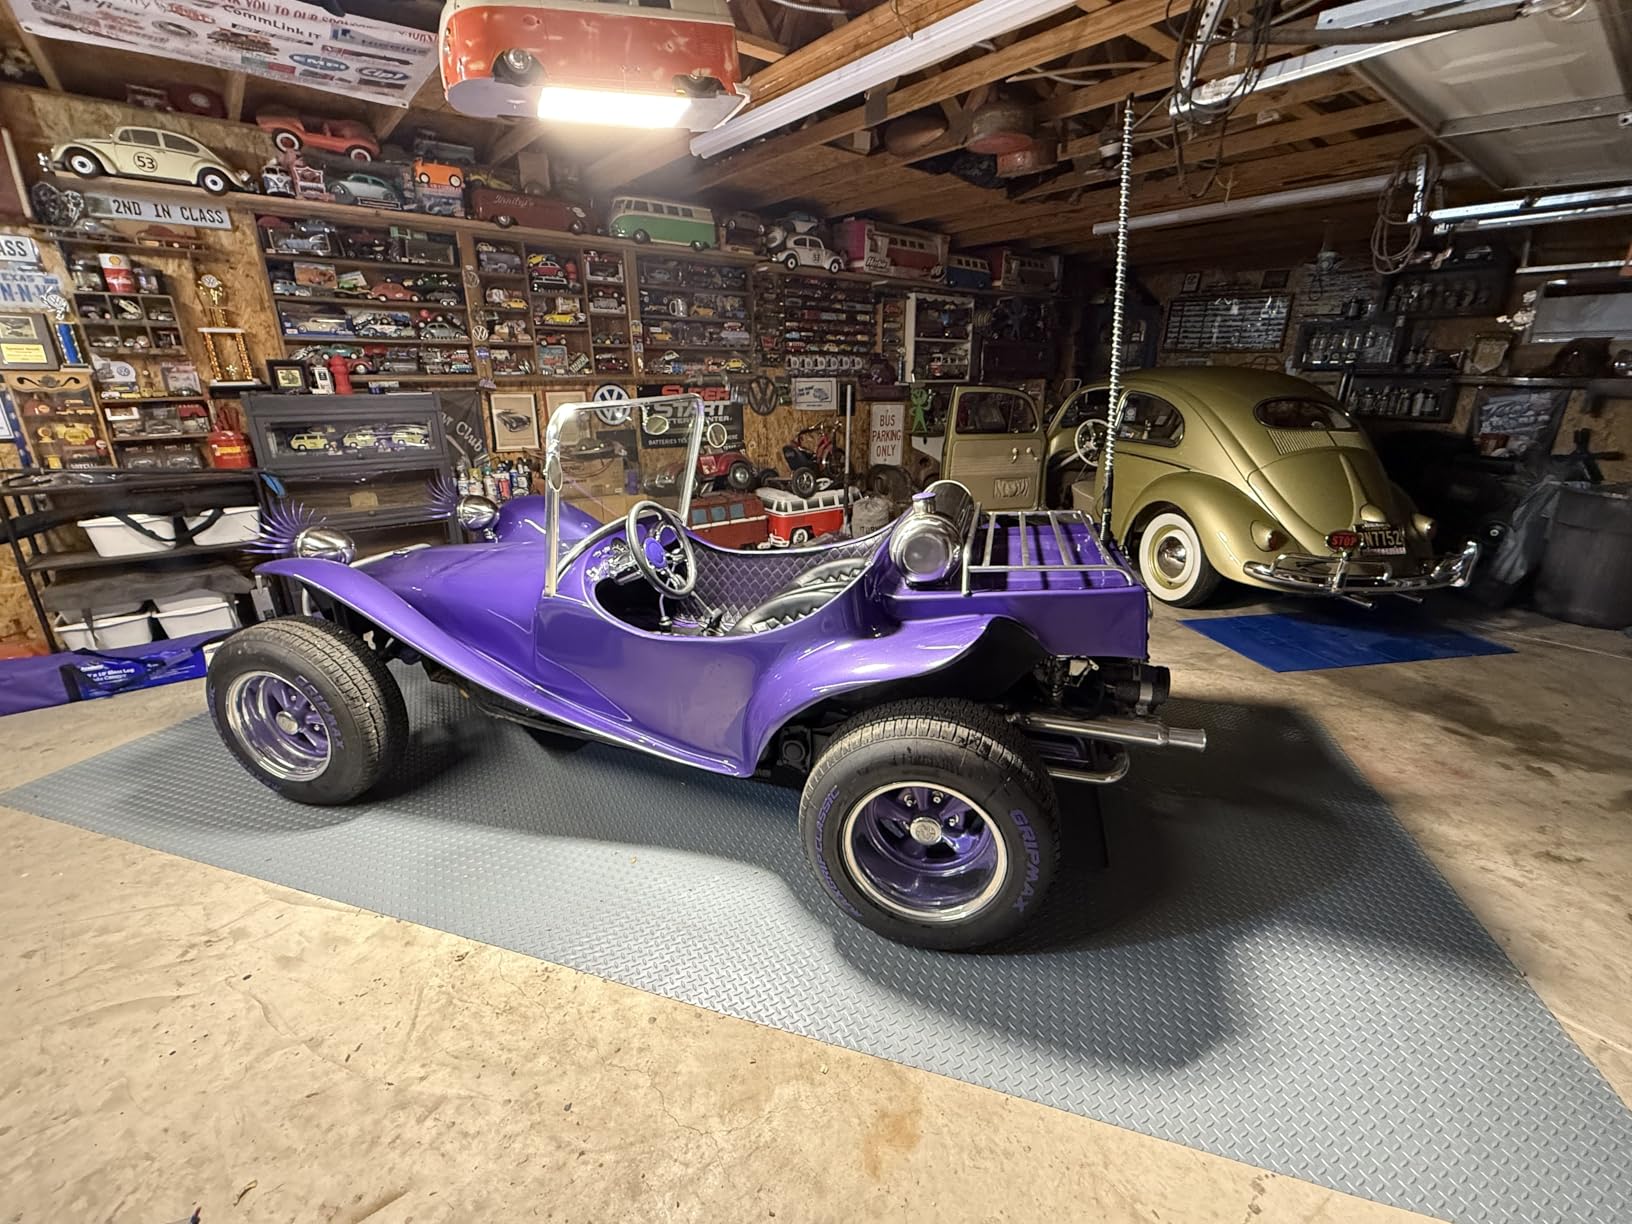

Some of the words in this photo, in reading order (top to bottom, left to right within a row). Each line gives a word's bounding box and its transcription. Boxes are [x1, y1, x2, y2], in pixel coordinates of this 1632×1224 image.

[246, 0, 271, 14] YOU
[273, 5, 291, 16] TO
[222, 5, 304, 37] CommLink
[307, 31, 322, 40] IT
[136, 156, 156, 171] 53
[112, 199, 142, 217] 2ND
[154, 203, 172, 220] IN
[181, 206, 224, 225] CLASS
[880, 414, 896, 427] BUS
[456, 420, 484, 452] Club
[872, 430, 901, 442] PARKING
[876, 444, 896, 457] ONLY
[1331, 535, 1357, 546] STOP
[814, 785, 840, 853] CLASSIC
[1009, 807, 1041, 914] GRIPMAX
